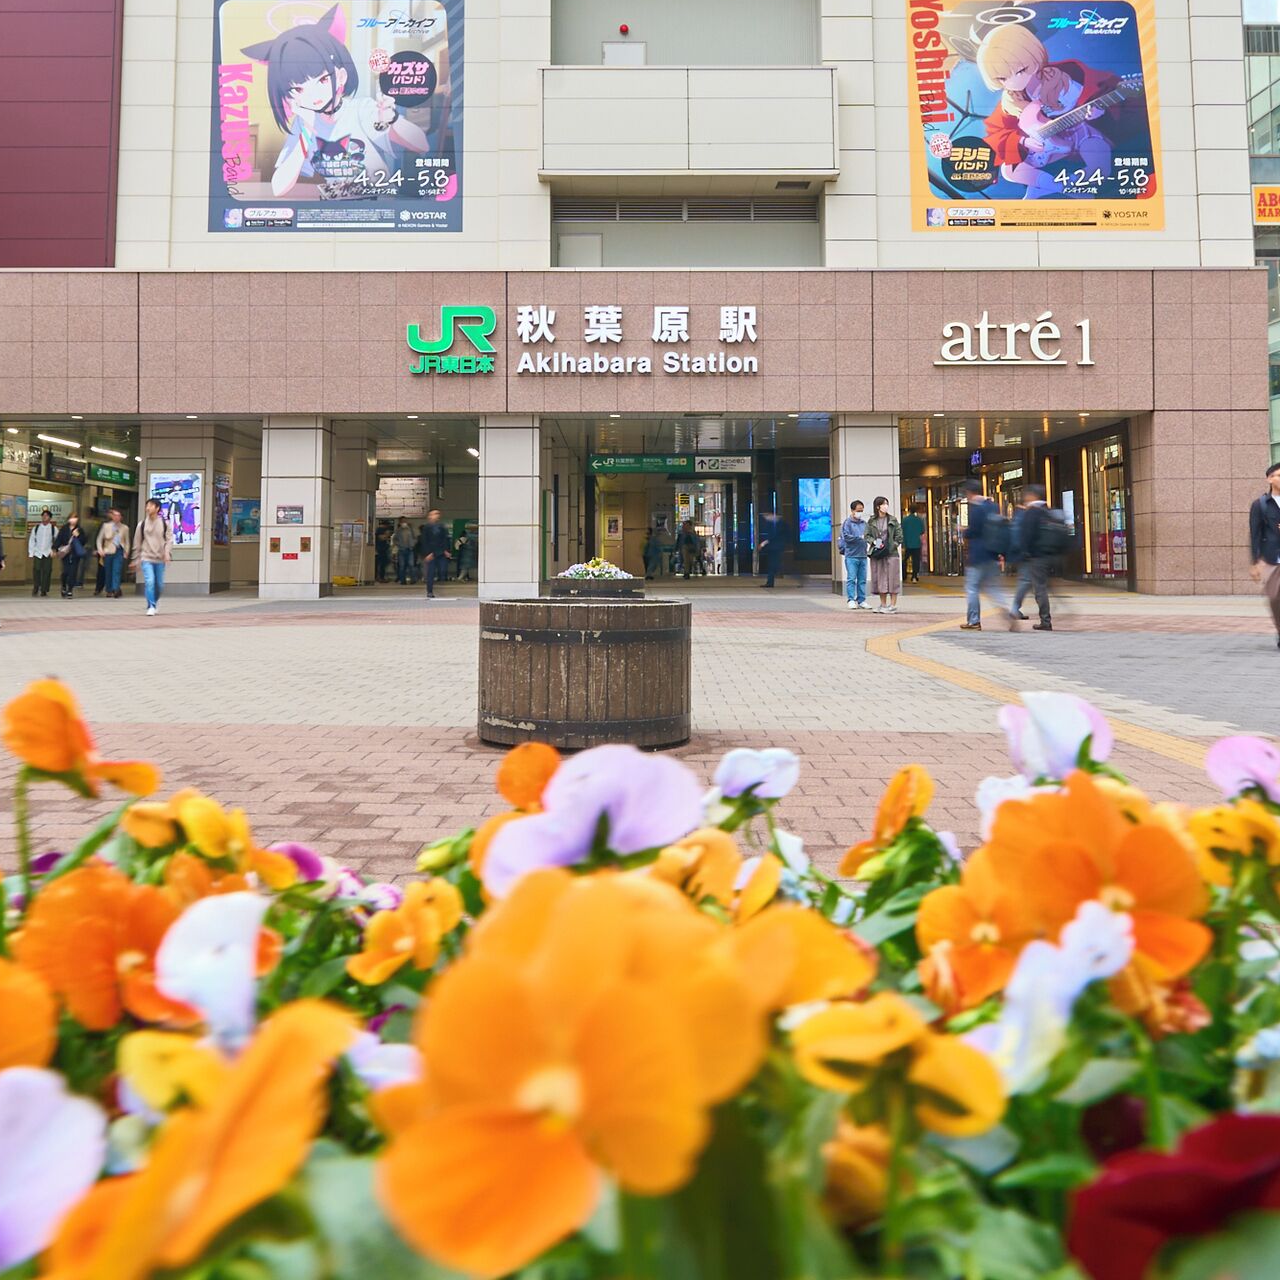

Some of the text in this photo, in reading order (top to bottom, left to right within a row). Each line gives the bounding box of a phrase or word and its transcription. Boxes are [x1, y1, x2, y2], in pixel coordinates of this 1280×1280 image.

[356, 18, 437, 28] ブルーアーカイブ
[1047, 17, 1129, 29] ブルーアーカイブ
[388, 62, 429, 75] カズサ
[949, 147, 991, 161] ヨシミ
[411, 211, 447, 219] YOSTAR
[407, 305, 497, 353] JR
[517, 305, 758, 344] 秋葉原駅
[941, 310, 1096, 365] atré 1
[409, 355, 495, 374] JR東日本
[517, 352, 758, 373] Akihabara Station
